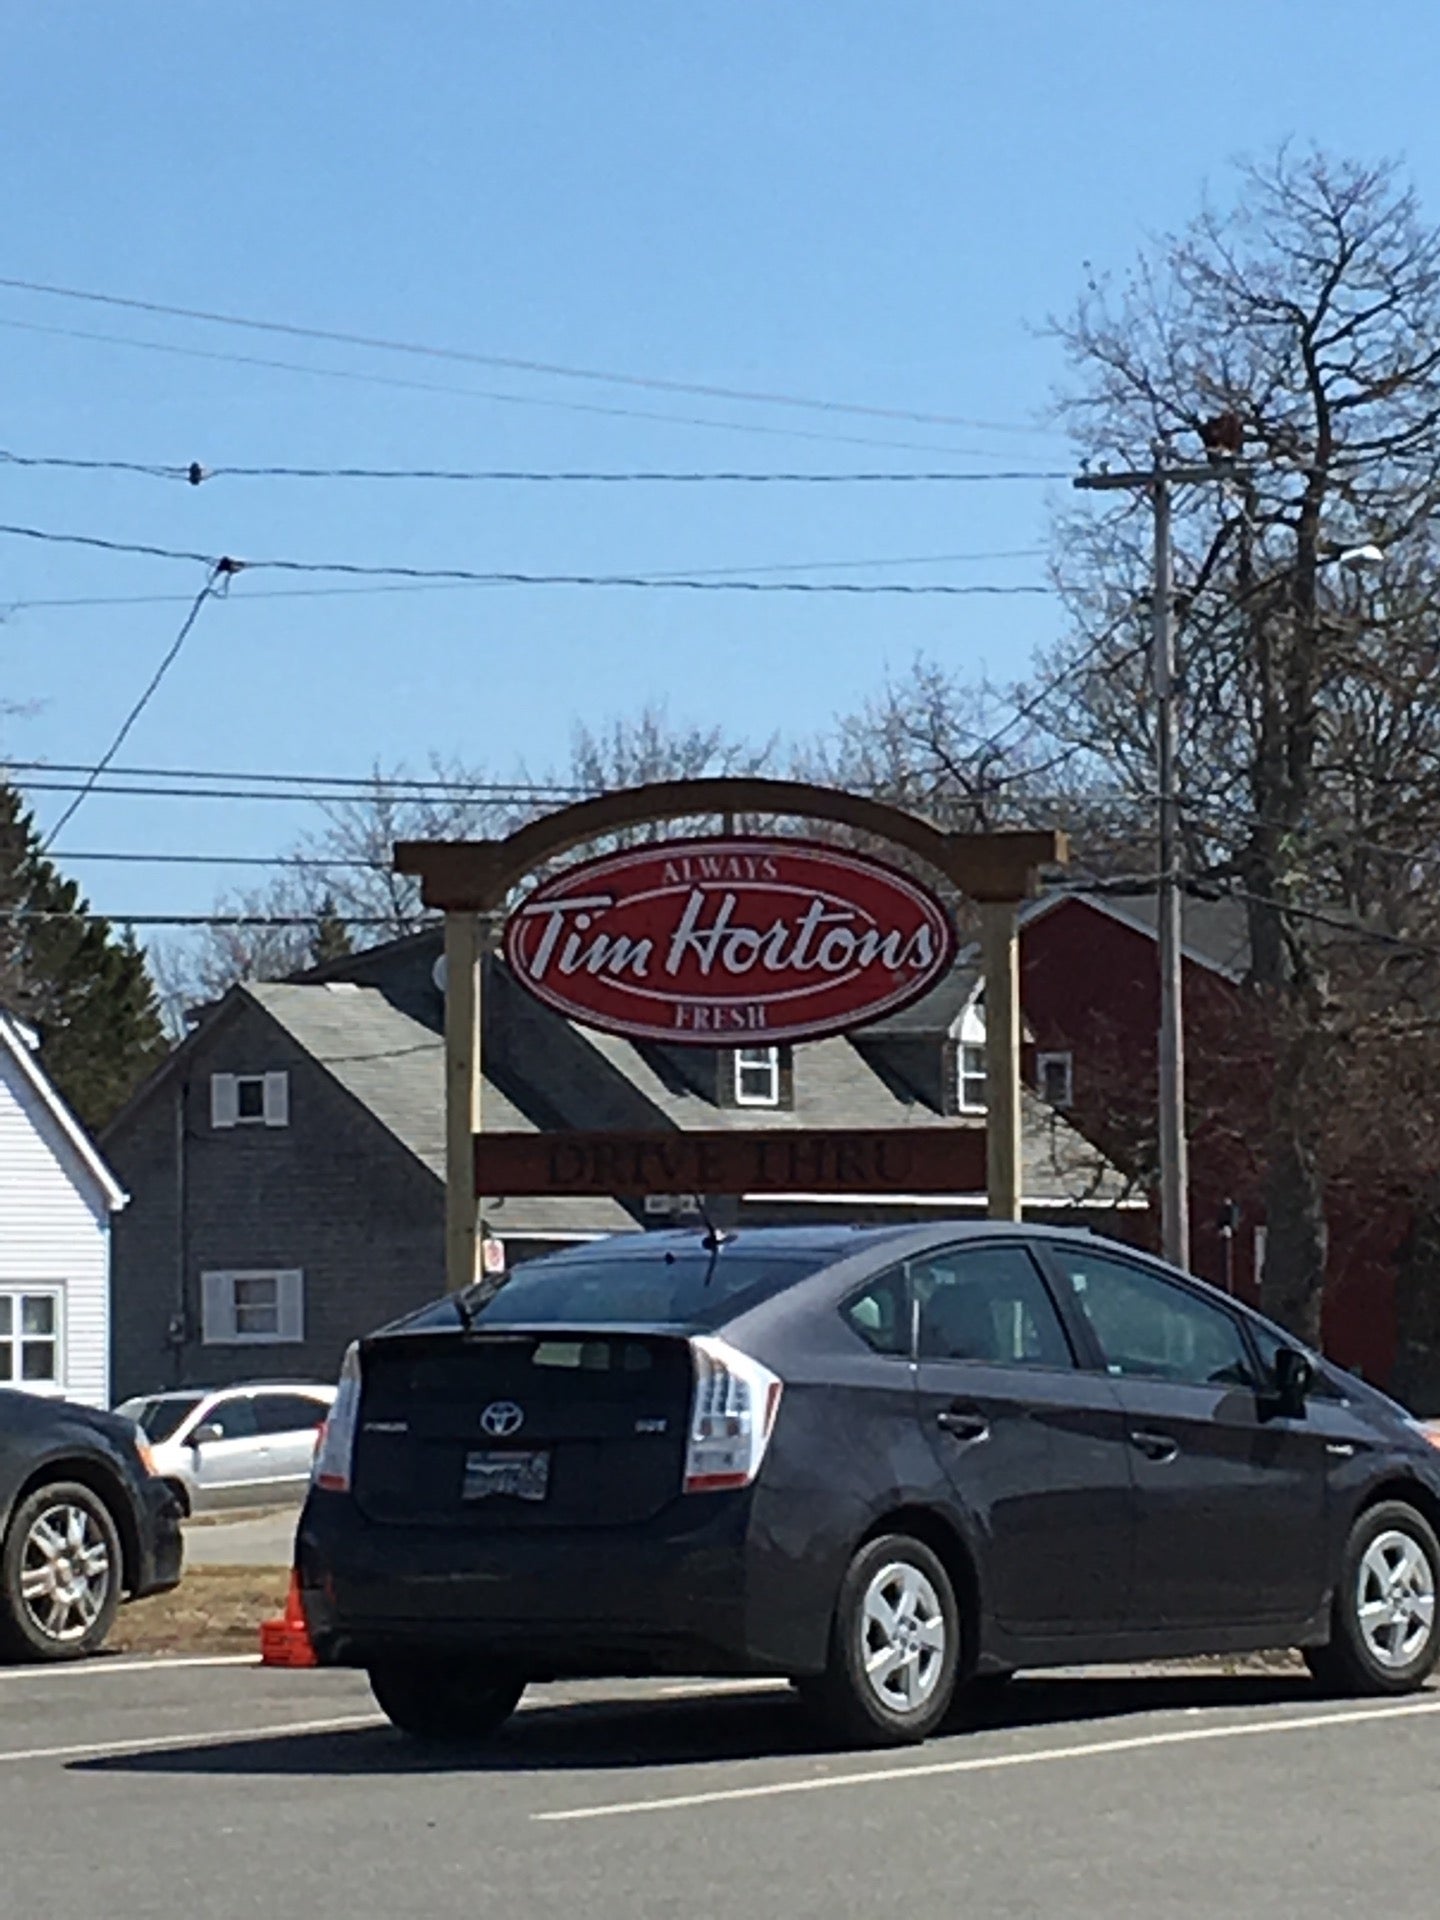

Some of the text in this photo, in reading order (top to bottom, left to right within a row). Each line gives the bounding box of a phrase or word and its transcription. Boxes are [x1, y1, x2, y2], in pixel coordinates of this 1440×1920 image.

[662, 856, 778, 884] ALWAYS
[522, 888, 936, 980] Tim Hortons
[674, 1003, 768, 1030] FRESH
[547, 1138, 916, 1187] DRIVE THRU
